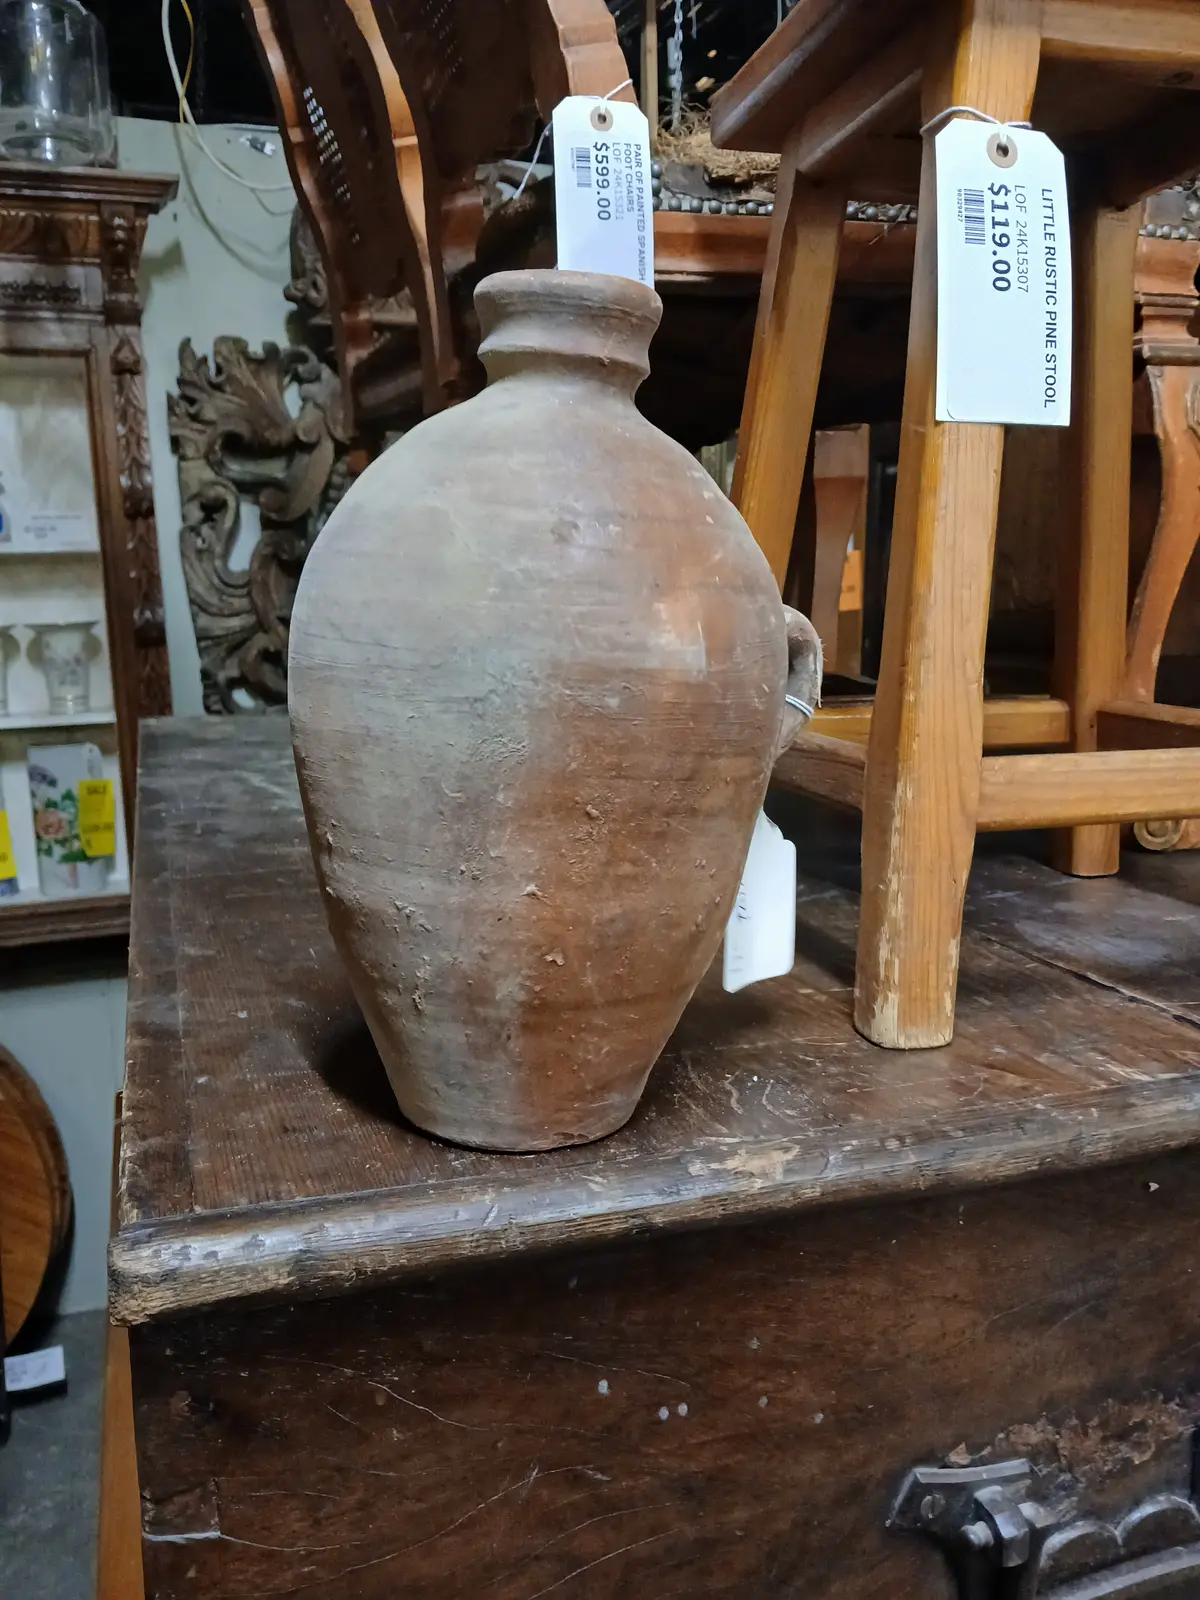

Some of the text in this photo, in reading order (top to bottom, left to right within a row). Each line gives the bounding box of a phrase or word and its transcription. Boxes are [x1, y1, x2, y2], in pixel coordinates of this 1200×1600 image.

[593, 142, 611, 220] $599.00
[612, 142, 623, 220] LOF 24K15321
[624, 143, 634, 212] FOOT CHAIRS
[634, 144, 646, 280] PAIR OF PAINTED SPANISH
[988, 182, 1011, 292] $119.00
[1014, 185, 1029, 293] LOF 24K15307
[1042, 188, 1057, 408] LITTLE RUSTIC PINE STOOL
